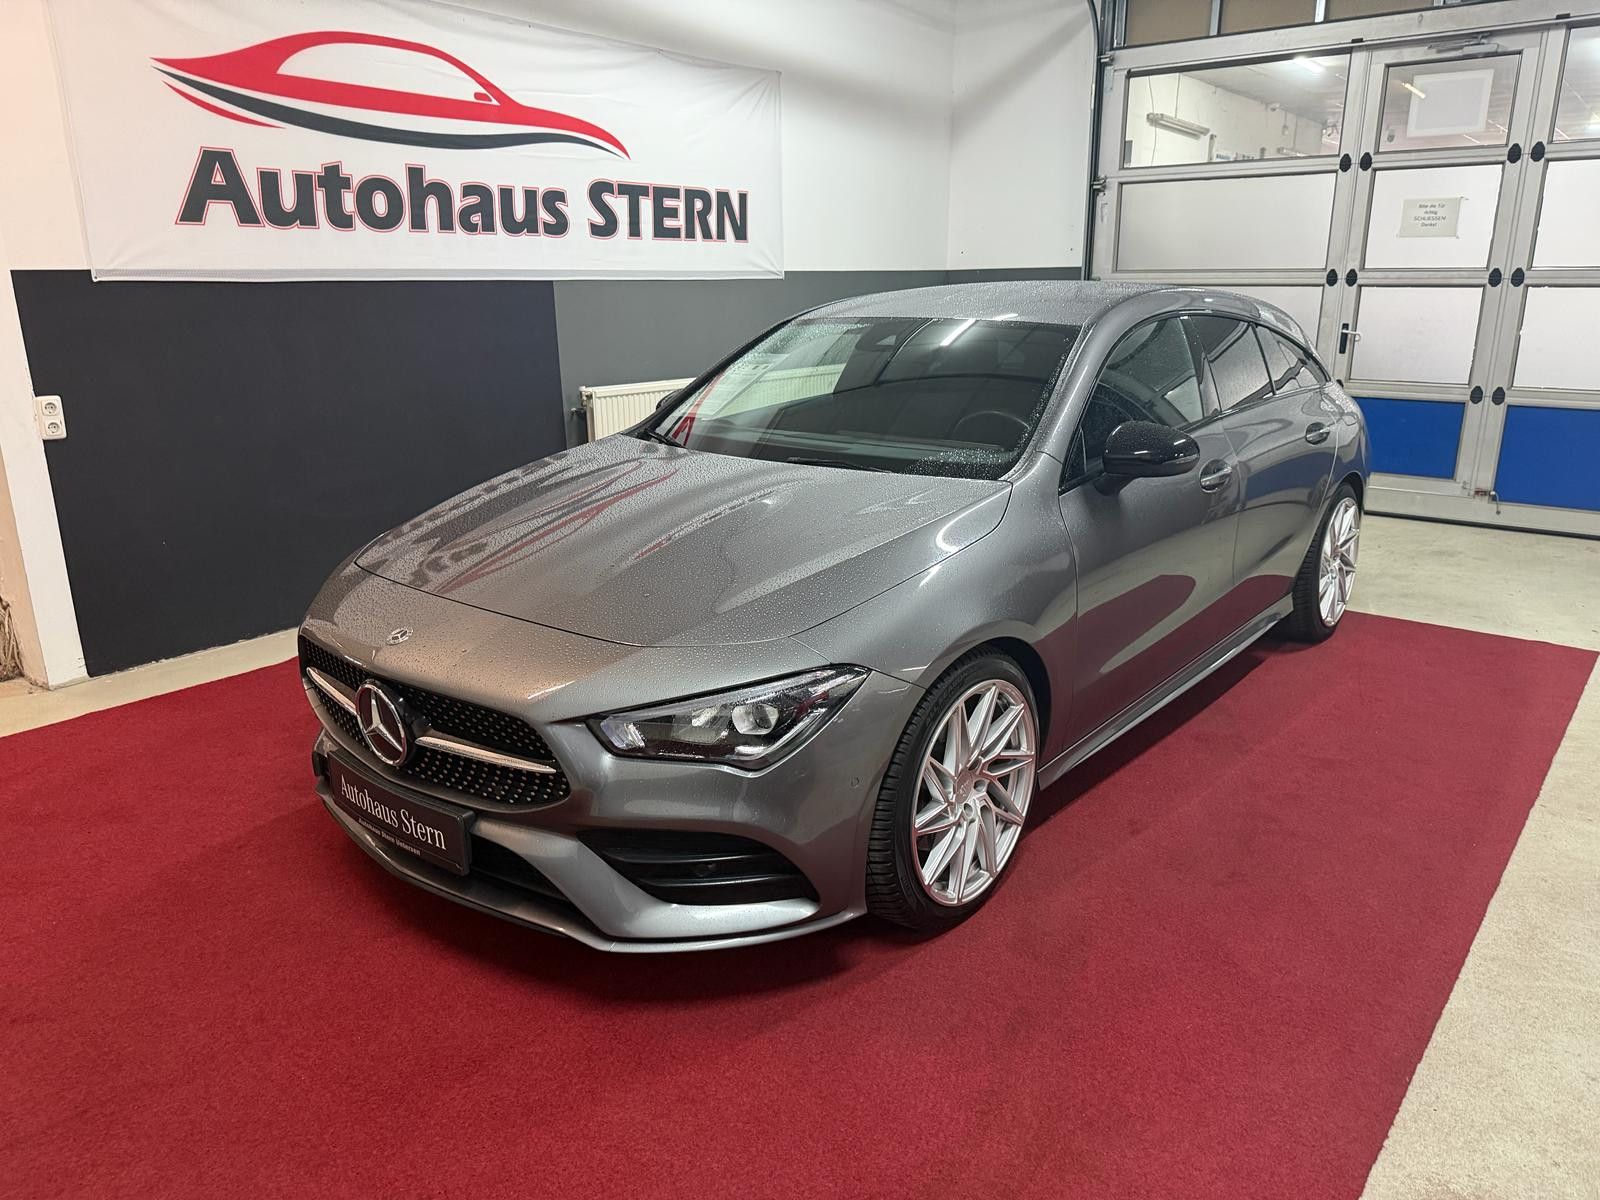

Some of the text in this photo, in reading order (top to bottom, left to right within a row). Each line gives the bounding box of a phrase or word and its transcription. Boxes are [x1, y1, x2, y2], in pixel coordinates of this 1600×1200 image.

[175, 146, 749, 243] Autohaus STERN
[341, 774, 446, 850] Autohaus Stern
